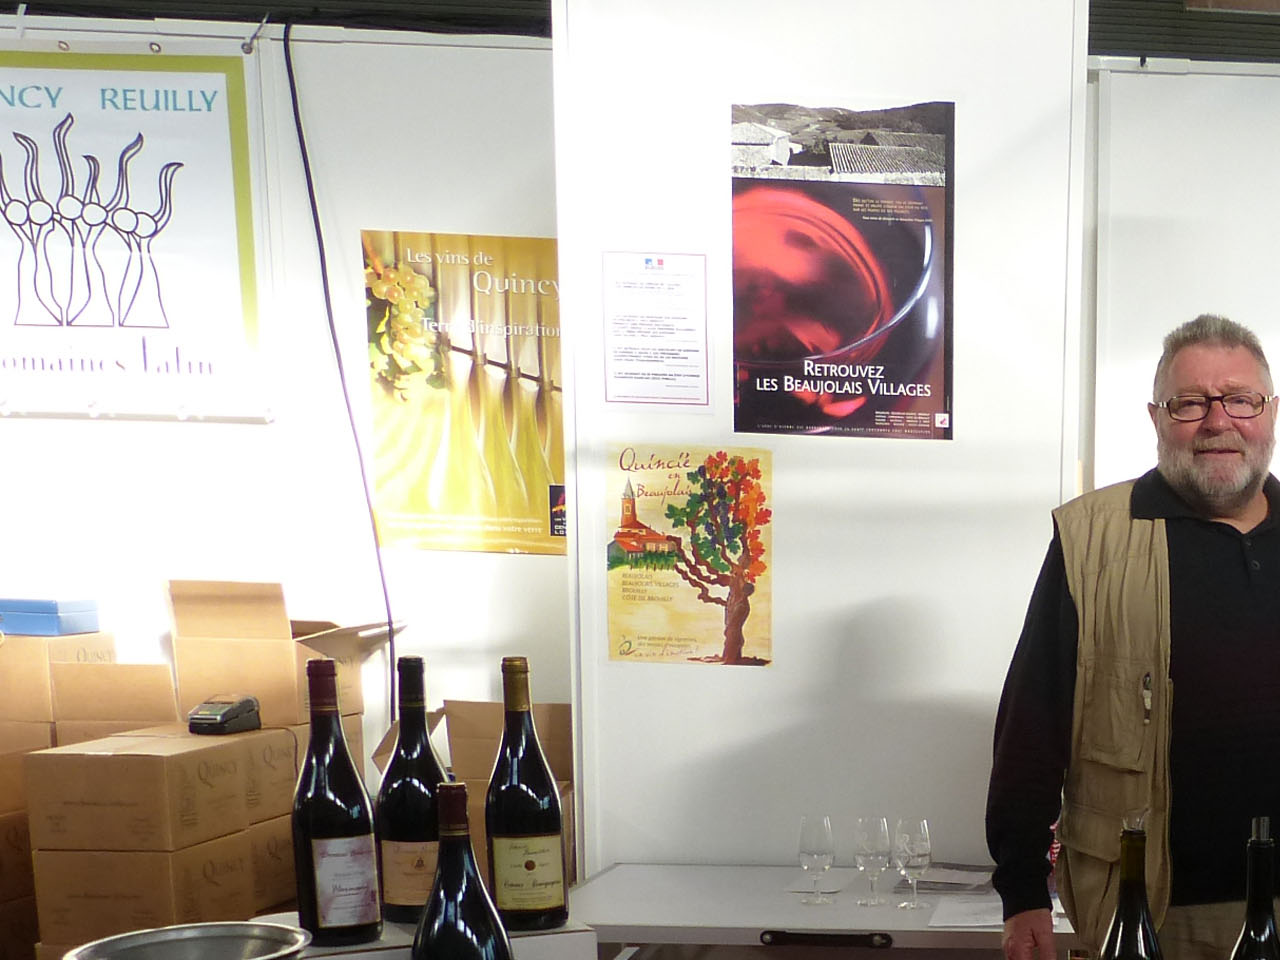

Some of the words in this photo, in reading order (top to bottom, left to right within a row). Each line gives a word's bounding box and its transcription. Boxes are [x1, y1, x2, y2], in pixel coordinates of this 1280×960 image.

[0, 85, 63, 109] NCY
[100, 87, 219, 112] REUILLY
[407, 247, 432, 263] Les
[436, 249, 470, 265] vins
[474, 251, 494, 266] de
[804, 359, 885, 379] RETROUVEZ
[784, 375, 863, 395] BEAUJOLAIS
[868, 379, 932, 397] VILLAGES
